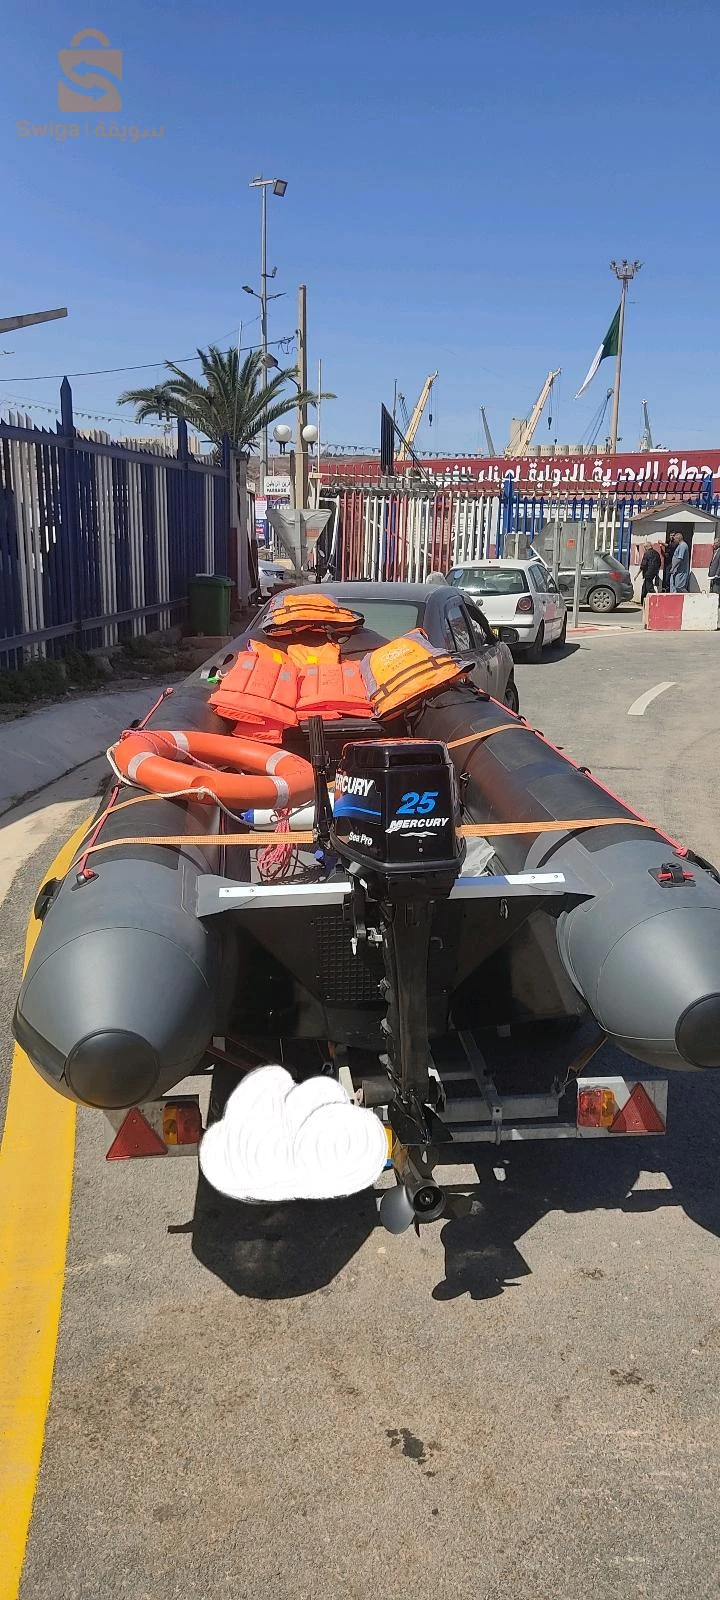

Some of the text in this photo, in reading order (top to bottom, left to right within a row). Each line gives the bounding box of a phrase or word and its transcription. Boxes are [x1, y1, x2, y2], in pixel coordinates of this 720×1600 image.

[528, 462, 585, 488] الدولية
[592, 460, 659, 487] البحرية
[396, 791, 439, 815] 25
[385, 817, 449, 834] MERCURY
[349, 831, 373, 846] Sea Pro
